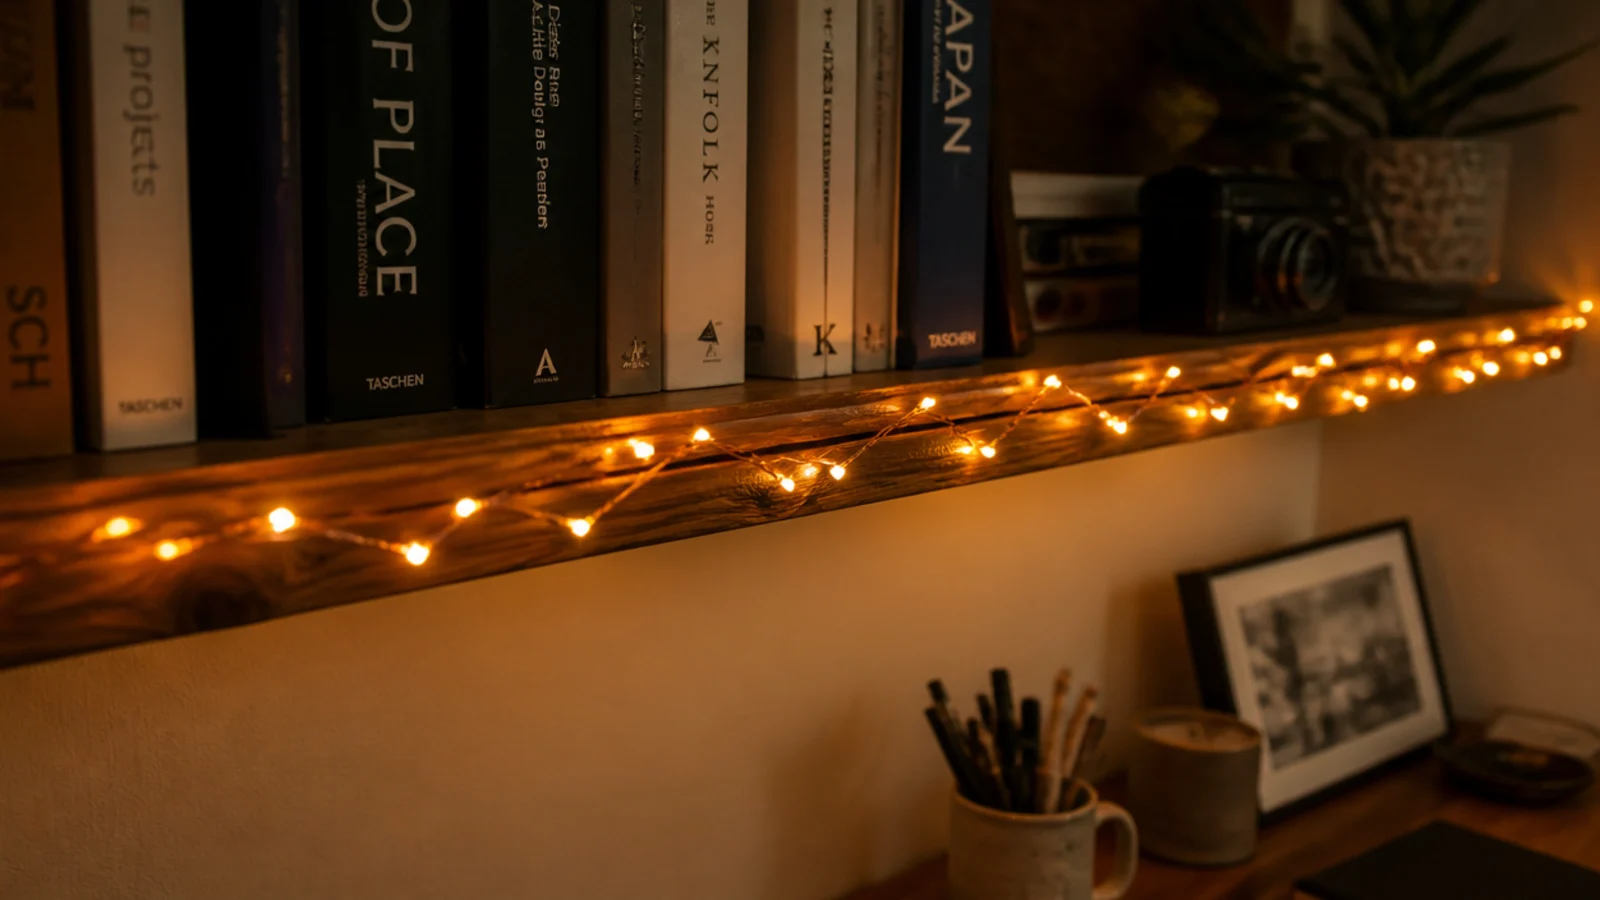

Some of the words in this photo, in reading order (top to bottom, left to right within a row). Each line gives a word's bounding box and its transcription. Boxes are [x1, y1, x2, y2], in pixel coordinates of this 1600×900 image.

[371, 0, 414, 73] OF
[702, 35, 719, 182] KNFOLK
[373, 97, 418, 297] PLACE
[7, 284, 50, 390] SCH
[812, 323, 838, 356] K
[927, 330, 977, 349] TASCHEN
[365, 372, 424, 391] TASCHEN
